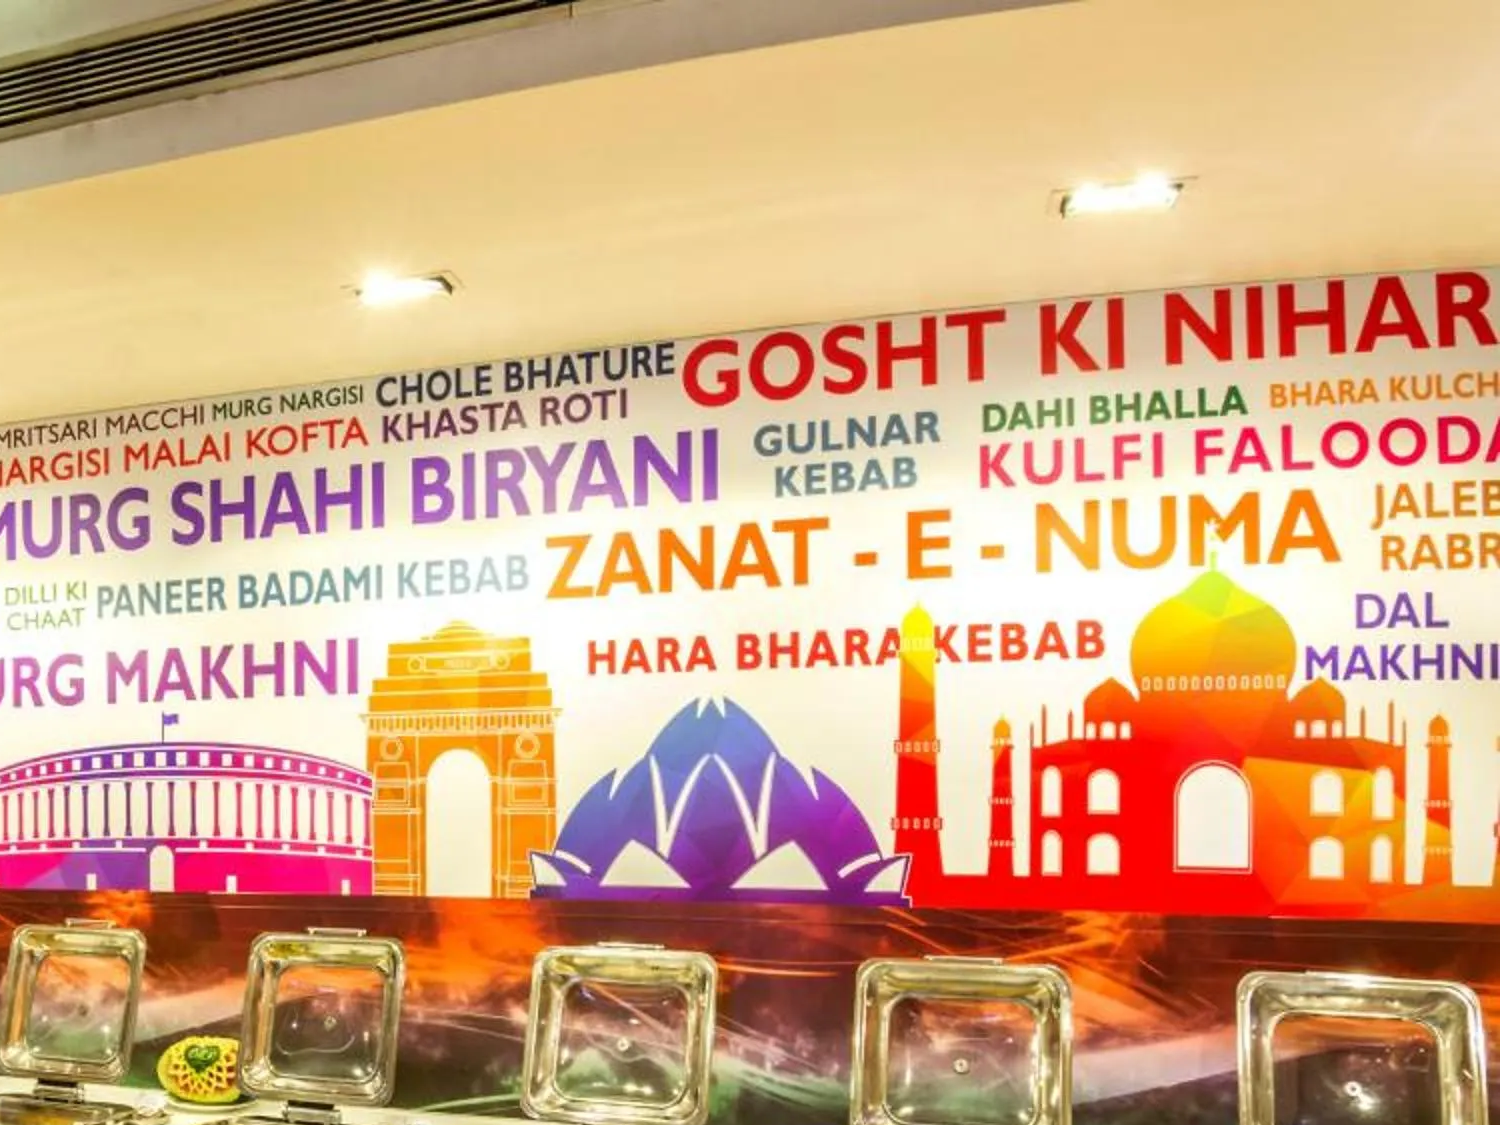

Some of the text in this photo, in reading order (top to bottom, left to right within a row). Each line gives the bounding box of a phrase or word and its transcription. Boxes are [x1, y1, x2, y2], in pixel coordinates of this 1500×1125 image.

[682, 271, 1499, 407] GOSHT KI NIHAR
[375, 341, 676, 407] CHOLE BHATURE
[1269, 371, 1500, 409] BHARA KULCH
[106, 406, 205, 436] MACCHI
[212, 384, 364, 422] MURG NARGISI
[382, 389, 628, 444] KHASTA ROTI
[982, 385, 1248, 433] DAHI BHALLA
[123, 432, 232, 473] MALAI
[245, 416, 369, 459] KOFTA
[753, 410, 942, 458] GULNAR
[775, 457, 918, 498] KEBAB
[978, 432, 1164, 489] KULFI
[170, 461, 386, 547] SHAHI
[412, 427, 719, 525] BIRYANI
[546, 517, 830, 600] ZANAT
[906, 508, 952, 580] E
[1035, 489, 1342, 573] NUMA
[5, 581, 87, 607] DILLI KI
[97, 554, 530, 619] PANEER BADAMI KEBAB
[1355, 591, 1450, 629] DAL
[7, 607, 86, 631] CHAAT
[106, 637, 360, 704] MAKHNI
[587, 619, 1105, 676] HARA BHARA KEBAB
[1305, 643, 1499, 681] MAKHNI
